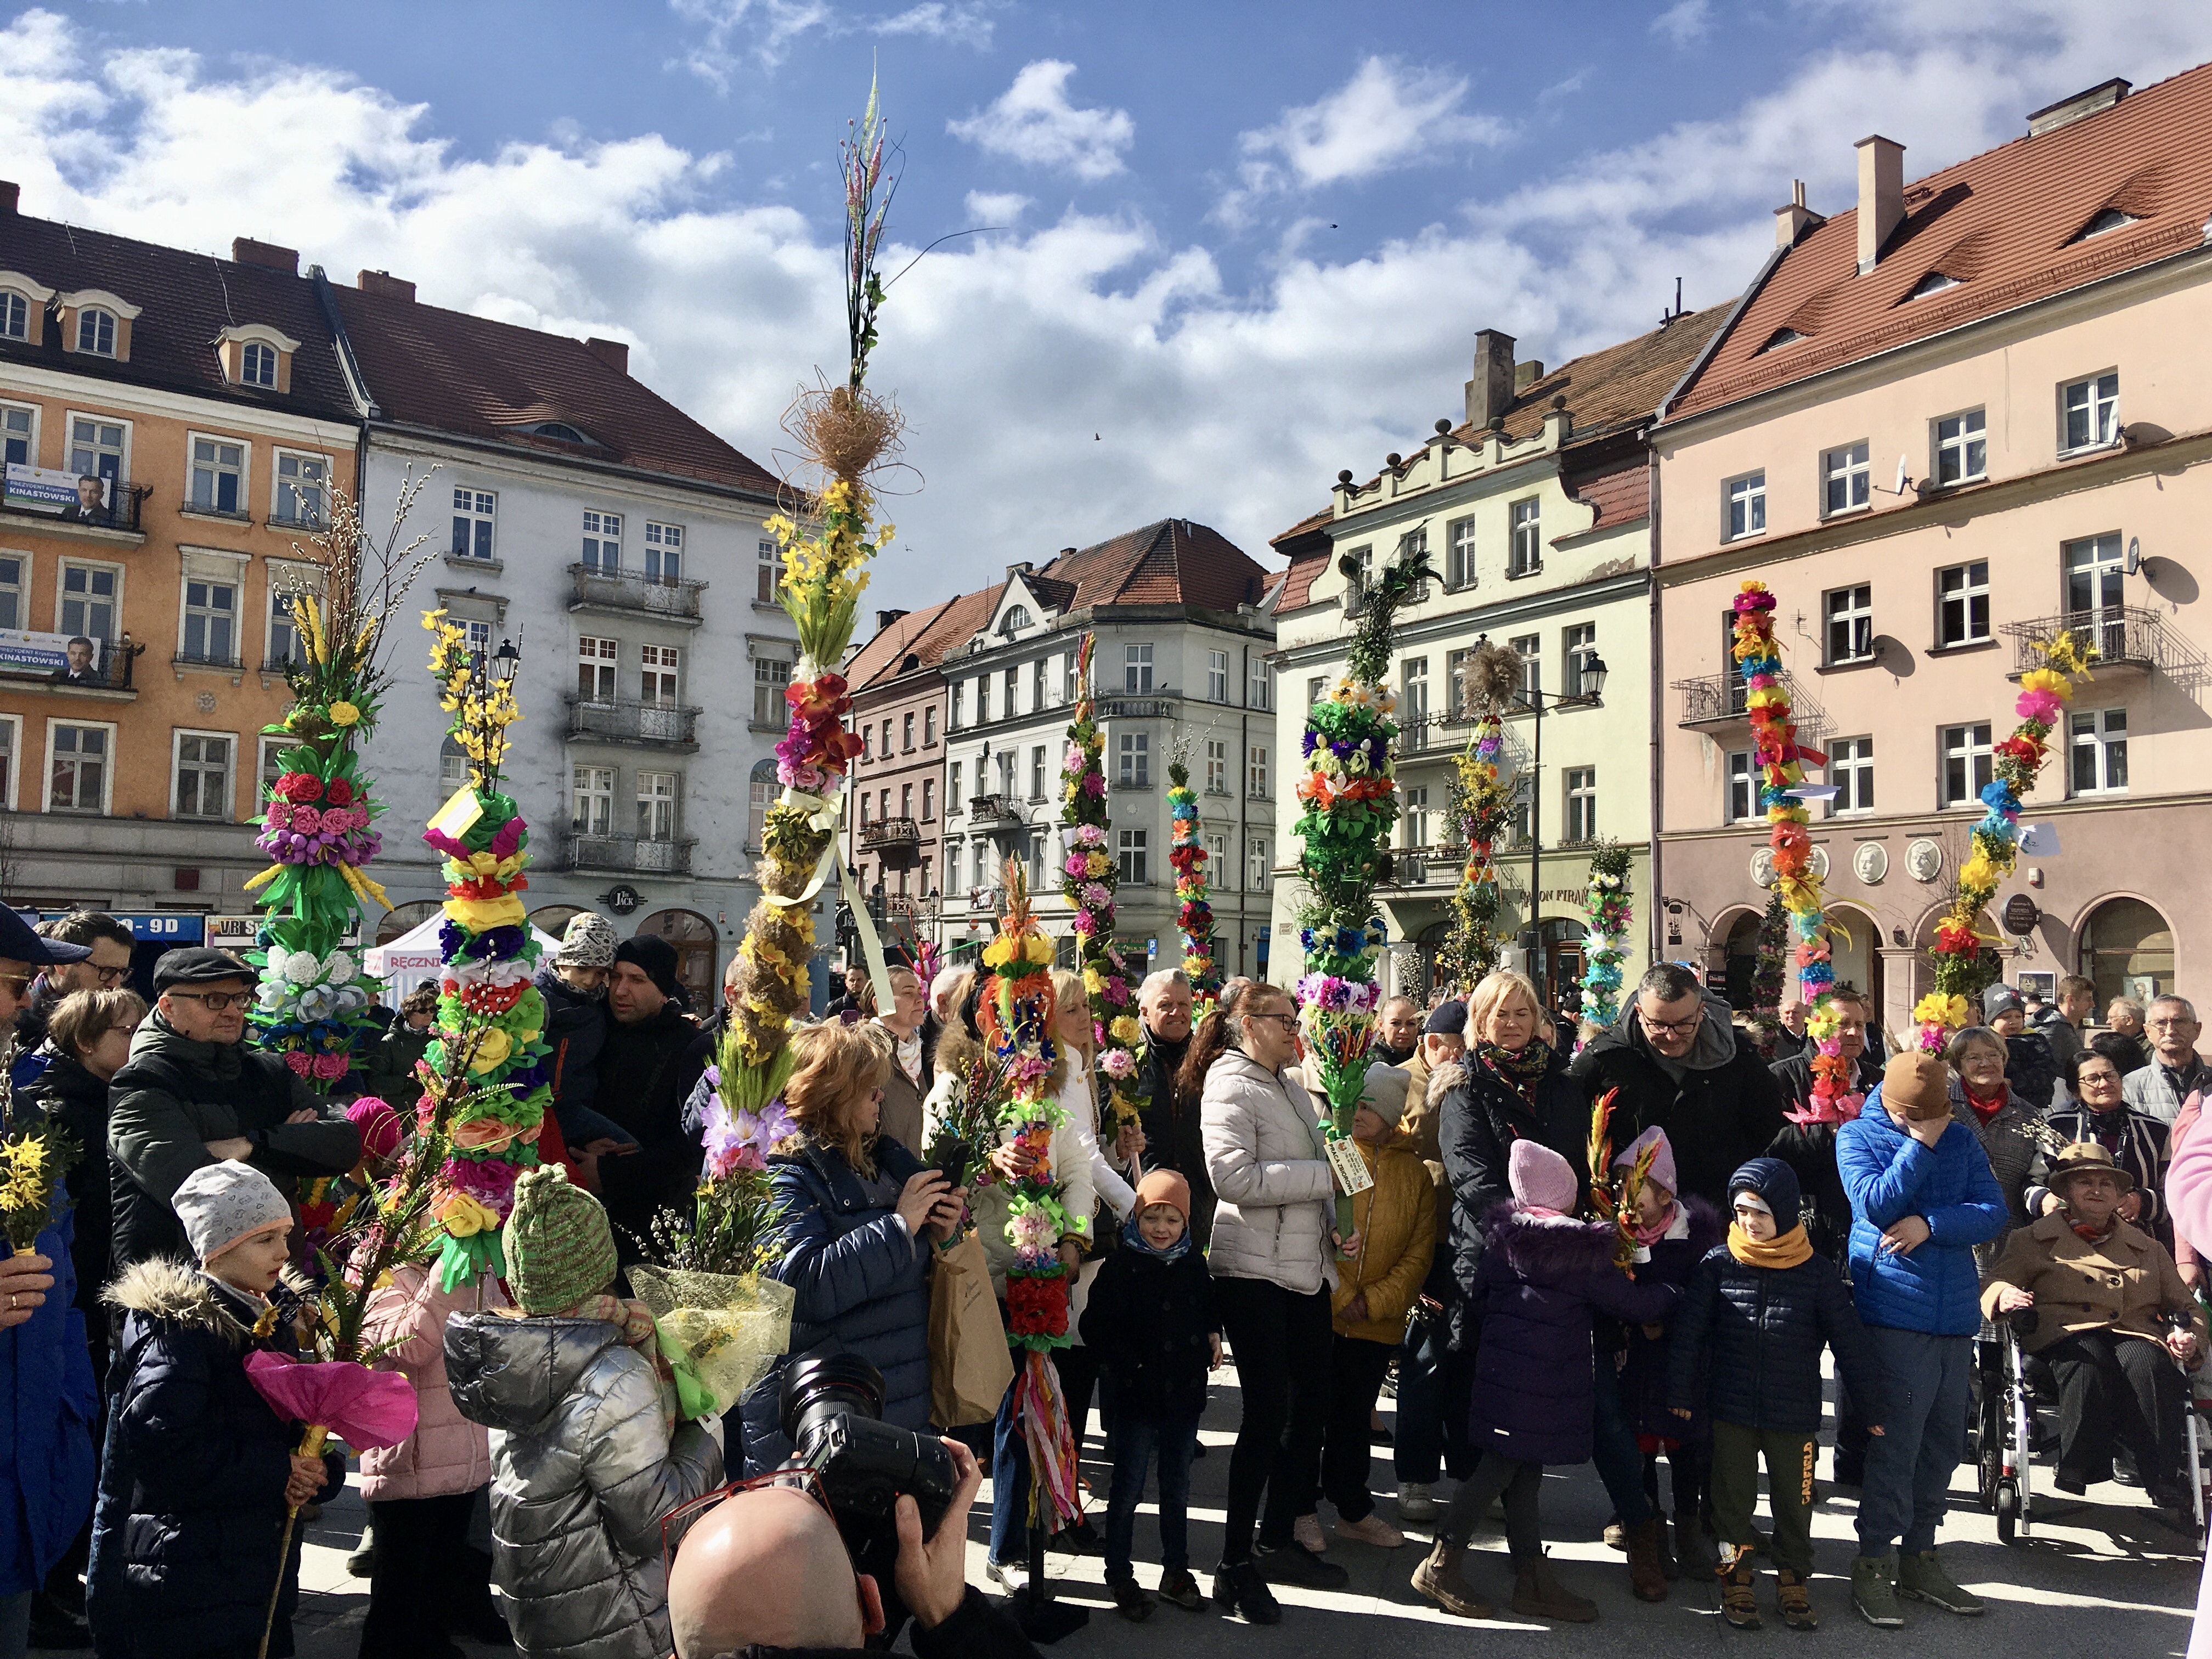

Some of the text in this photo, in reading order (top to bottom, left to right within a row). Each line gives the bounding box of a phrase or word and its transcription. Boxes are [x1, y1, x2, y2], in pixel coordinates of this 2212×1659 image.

[10, 481, 44, 490] PREZYDENT
[9, 487, 75, 503] KINASTOWSKI
[1520, 890, 1554, 907] SAON
[150, 918, 178, 933] 9D
[221, 919, 240, 934] VR
[1149, 941, 1155, 950] P
[391, 956, 441, 969] RĘCZNI
[1329, 1143, 1340, 1164] PRACA
[1338, 1163, 1355, 1194] ZBIOROWA
[1802, 1441, 1813, 1505] GARFIELD
